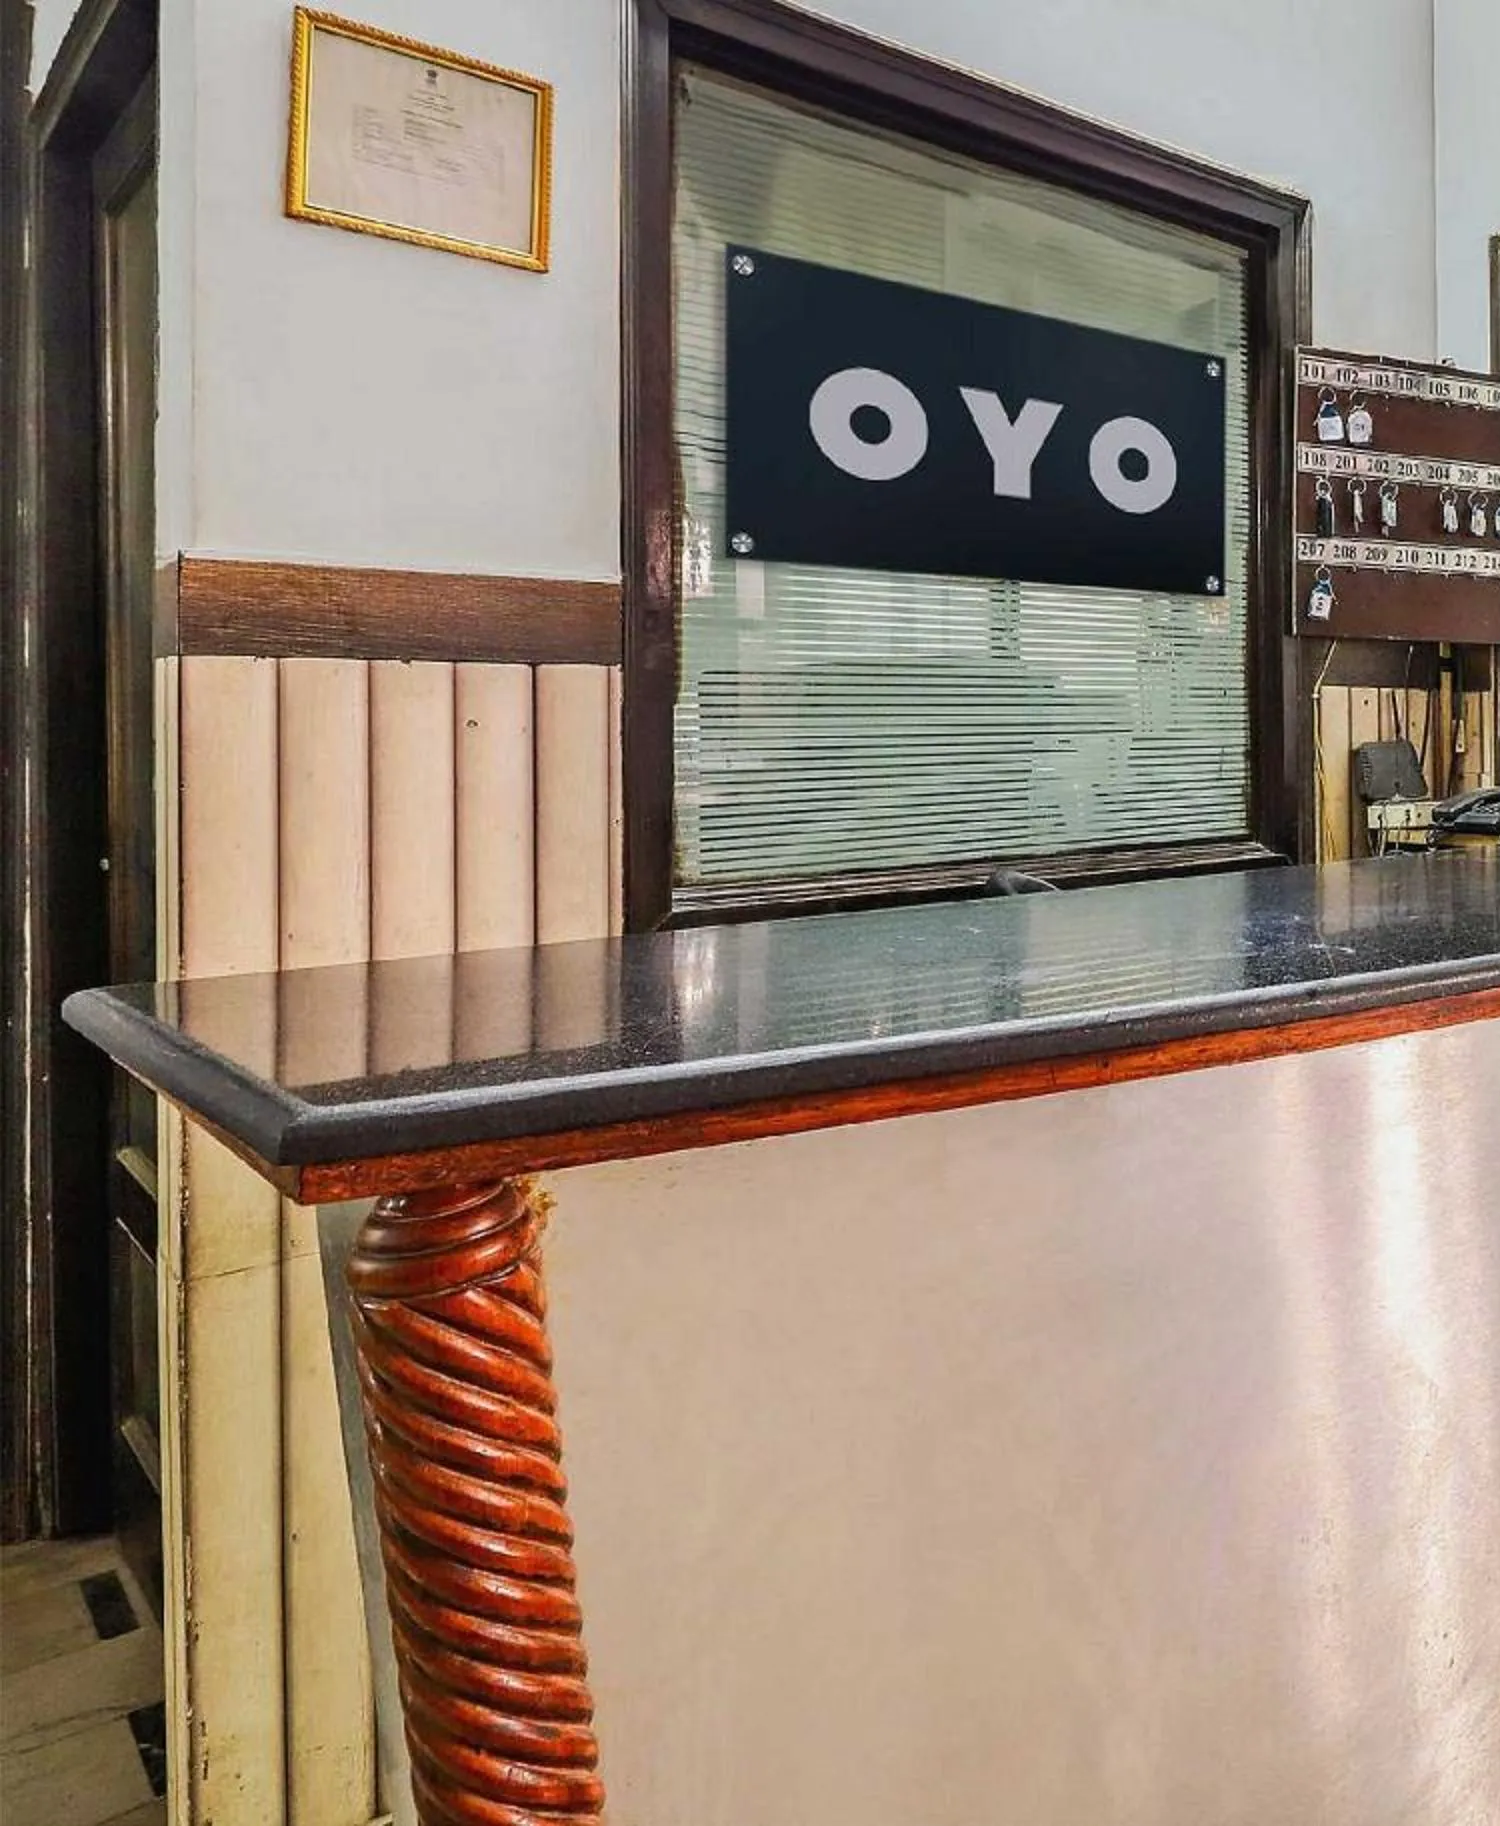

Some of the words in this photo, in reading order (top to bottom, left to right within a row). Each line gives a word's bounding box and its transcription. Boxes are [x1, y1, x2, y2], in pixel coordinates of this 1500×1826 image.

[1302, 363, 1325, 379] 101
[1337, 368, 1359, 384] 102
[1369, 373, 1391, 388] 103
[1399, 376, 1421, 393] 104
[1429, 381, 1451, 396] 105
[1459, 386, 1480, 400] 106
[808, 366, 1177, 514] OYO
[1304, 451, 1327, 466] 108
[1336, 455, 1358, 470] 201
[1368, 459, 1390, 473] 202
[1398, 462, 1420, 477] 203
[1428, 465, 1451, 480] 204
[1459, 469, 1480, 484] 205
[1301, 541, 1325, 557] 207
[1334, 545, 1357, 560] 208
[1365, 548, 1389, 561] 209
[1395, 550, 1419, 563] 210
[1426, 552, 1446, 565] 211
[1455, 554, 1477, 568] 212
